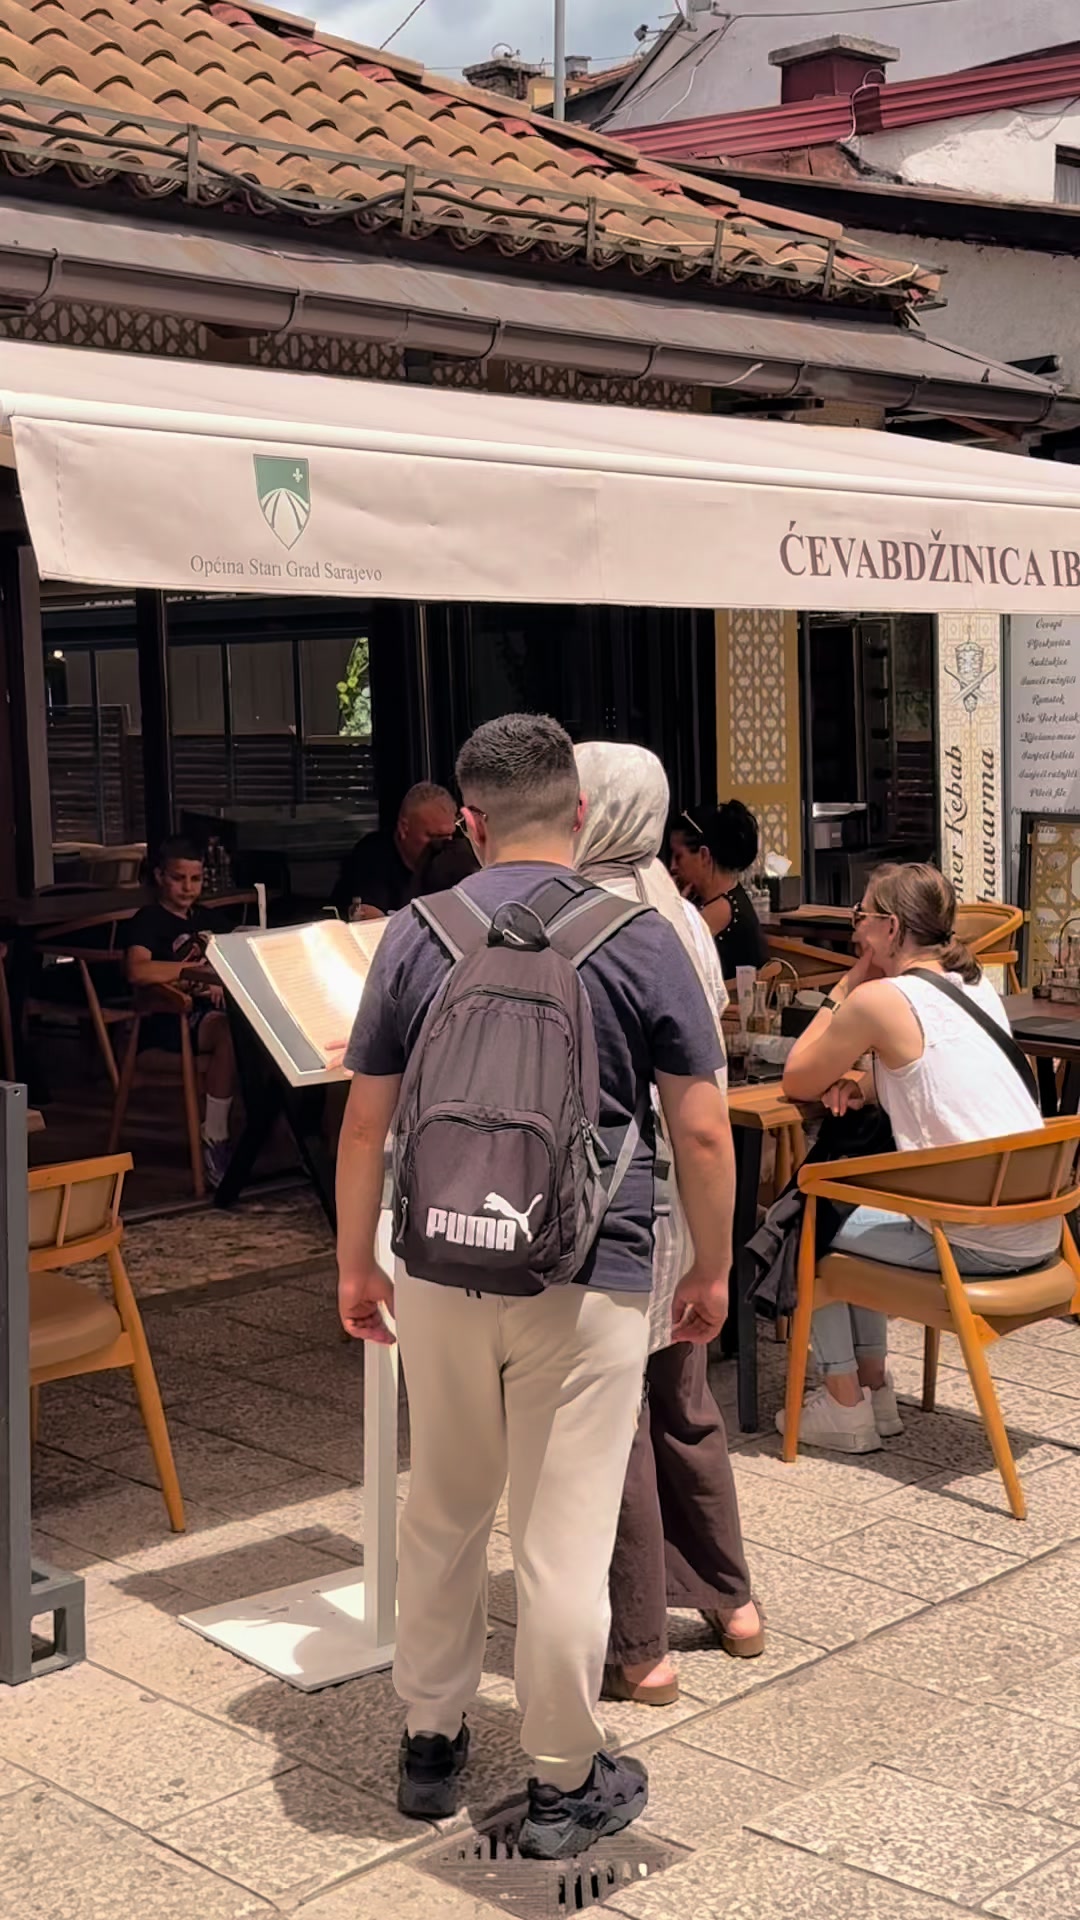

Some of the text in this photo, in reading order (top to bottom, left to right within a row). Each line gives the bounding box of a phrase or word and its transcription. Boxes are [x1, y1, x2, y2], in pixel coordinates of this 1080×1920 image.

[190, 555, 244, 578] Općina
[286, 560, 320, 578] Grad
[324, 562, 382, 584] Sarajevo
[779, 520, 1046, 587] ĆEVABDŽINICA
[944, 745, 967, 836] Kebab
[425, 1207, 518, 1252] PUMA
